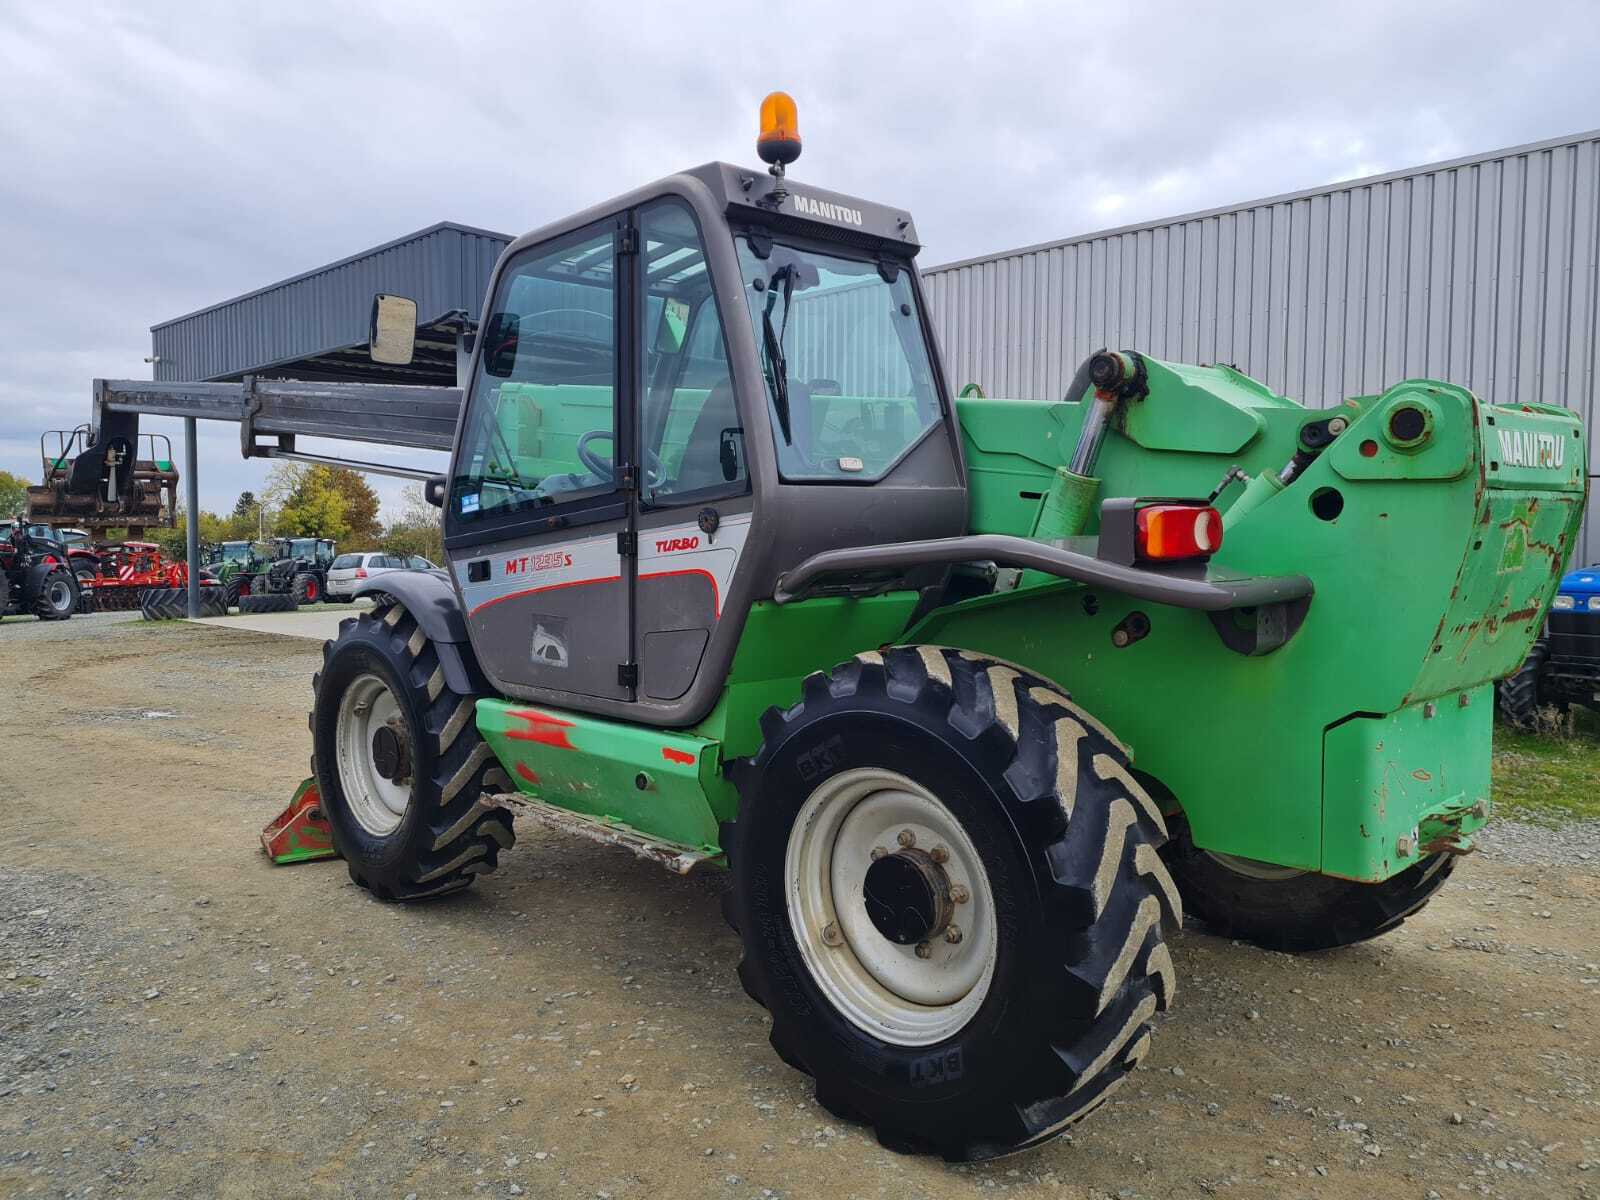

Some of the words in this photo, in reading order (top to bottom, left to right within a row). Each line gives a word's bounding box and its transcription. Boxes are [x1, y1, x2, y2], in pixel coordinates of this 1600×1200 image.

[794, 195, 862, 225] MANITOU
[1498, 430, 1564, 469] MANITOU
[656, 536, 699, 553] TURBO
[506, 556, 528, 575] MT
